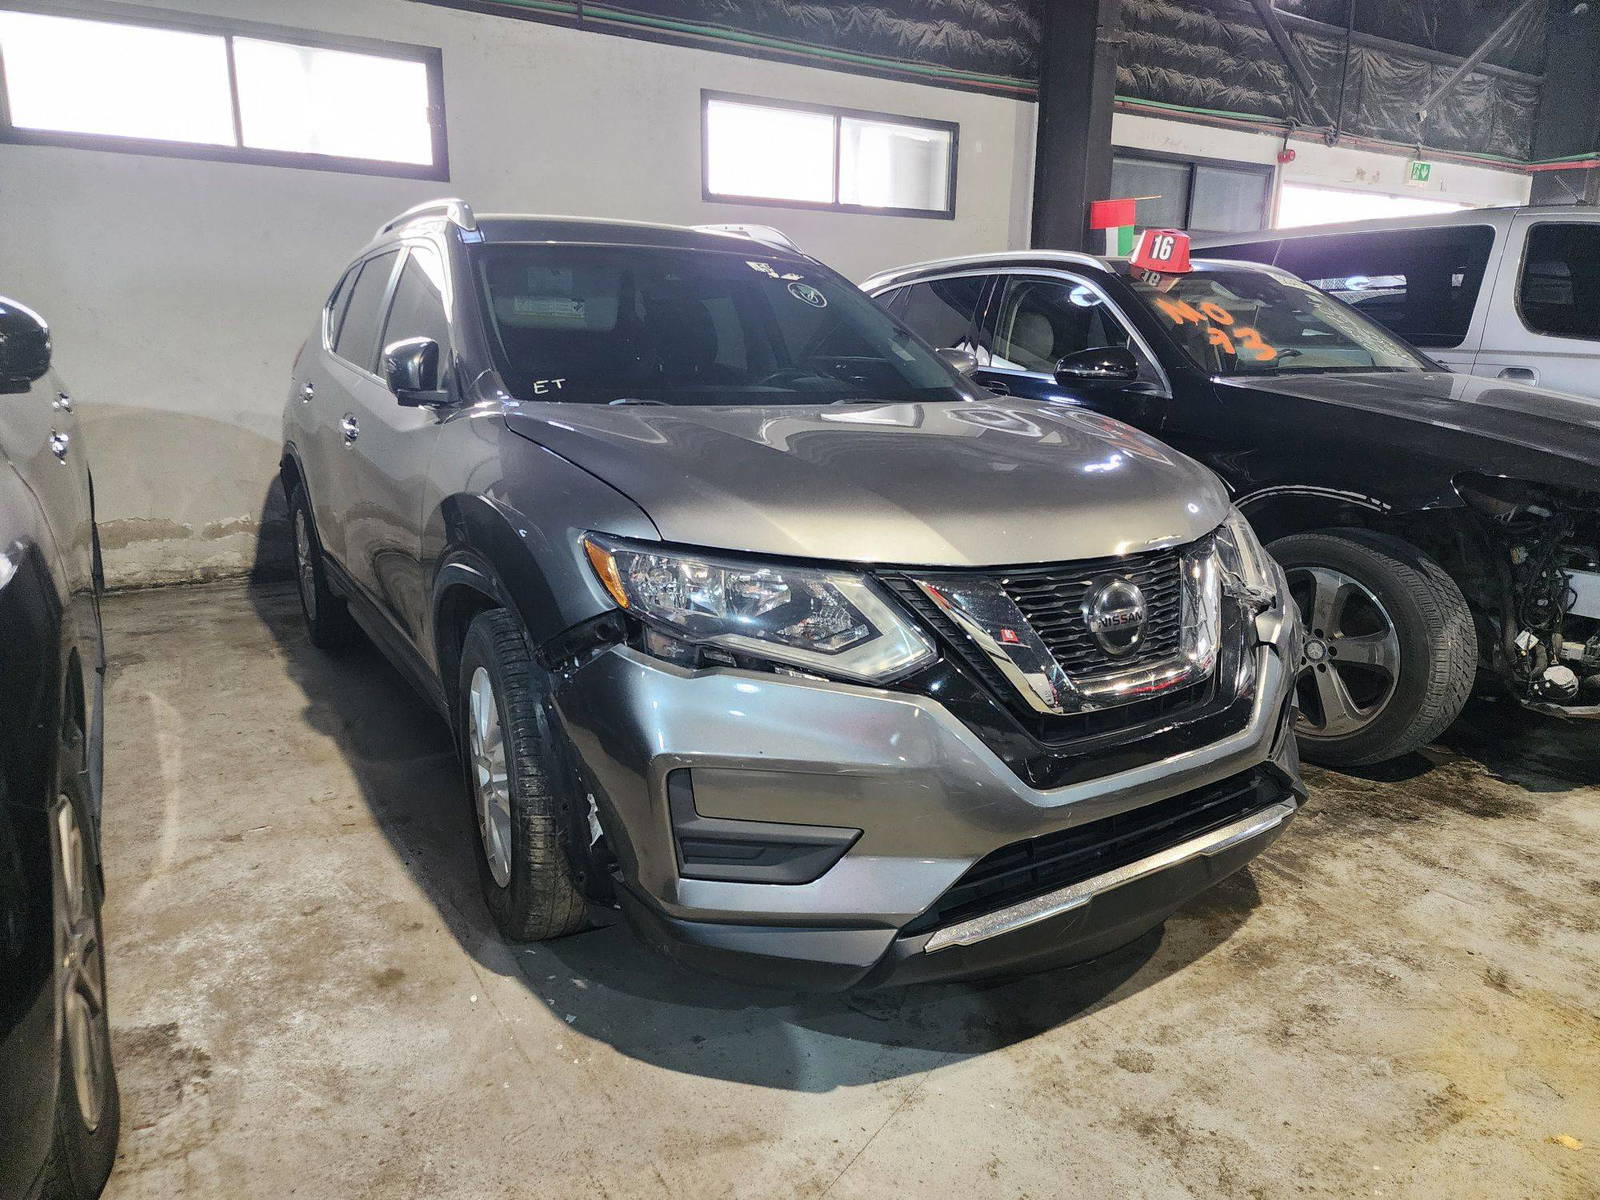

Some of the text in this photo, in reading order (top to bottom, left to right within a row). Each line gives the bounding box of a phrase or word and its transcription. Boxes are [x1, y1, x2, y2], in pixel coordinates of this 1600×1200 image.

[1151, 234, 1174, 260] 16
[533, 378, 566, 395] ET
[1098, 611, 1143, 628] NISSAN
